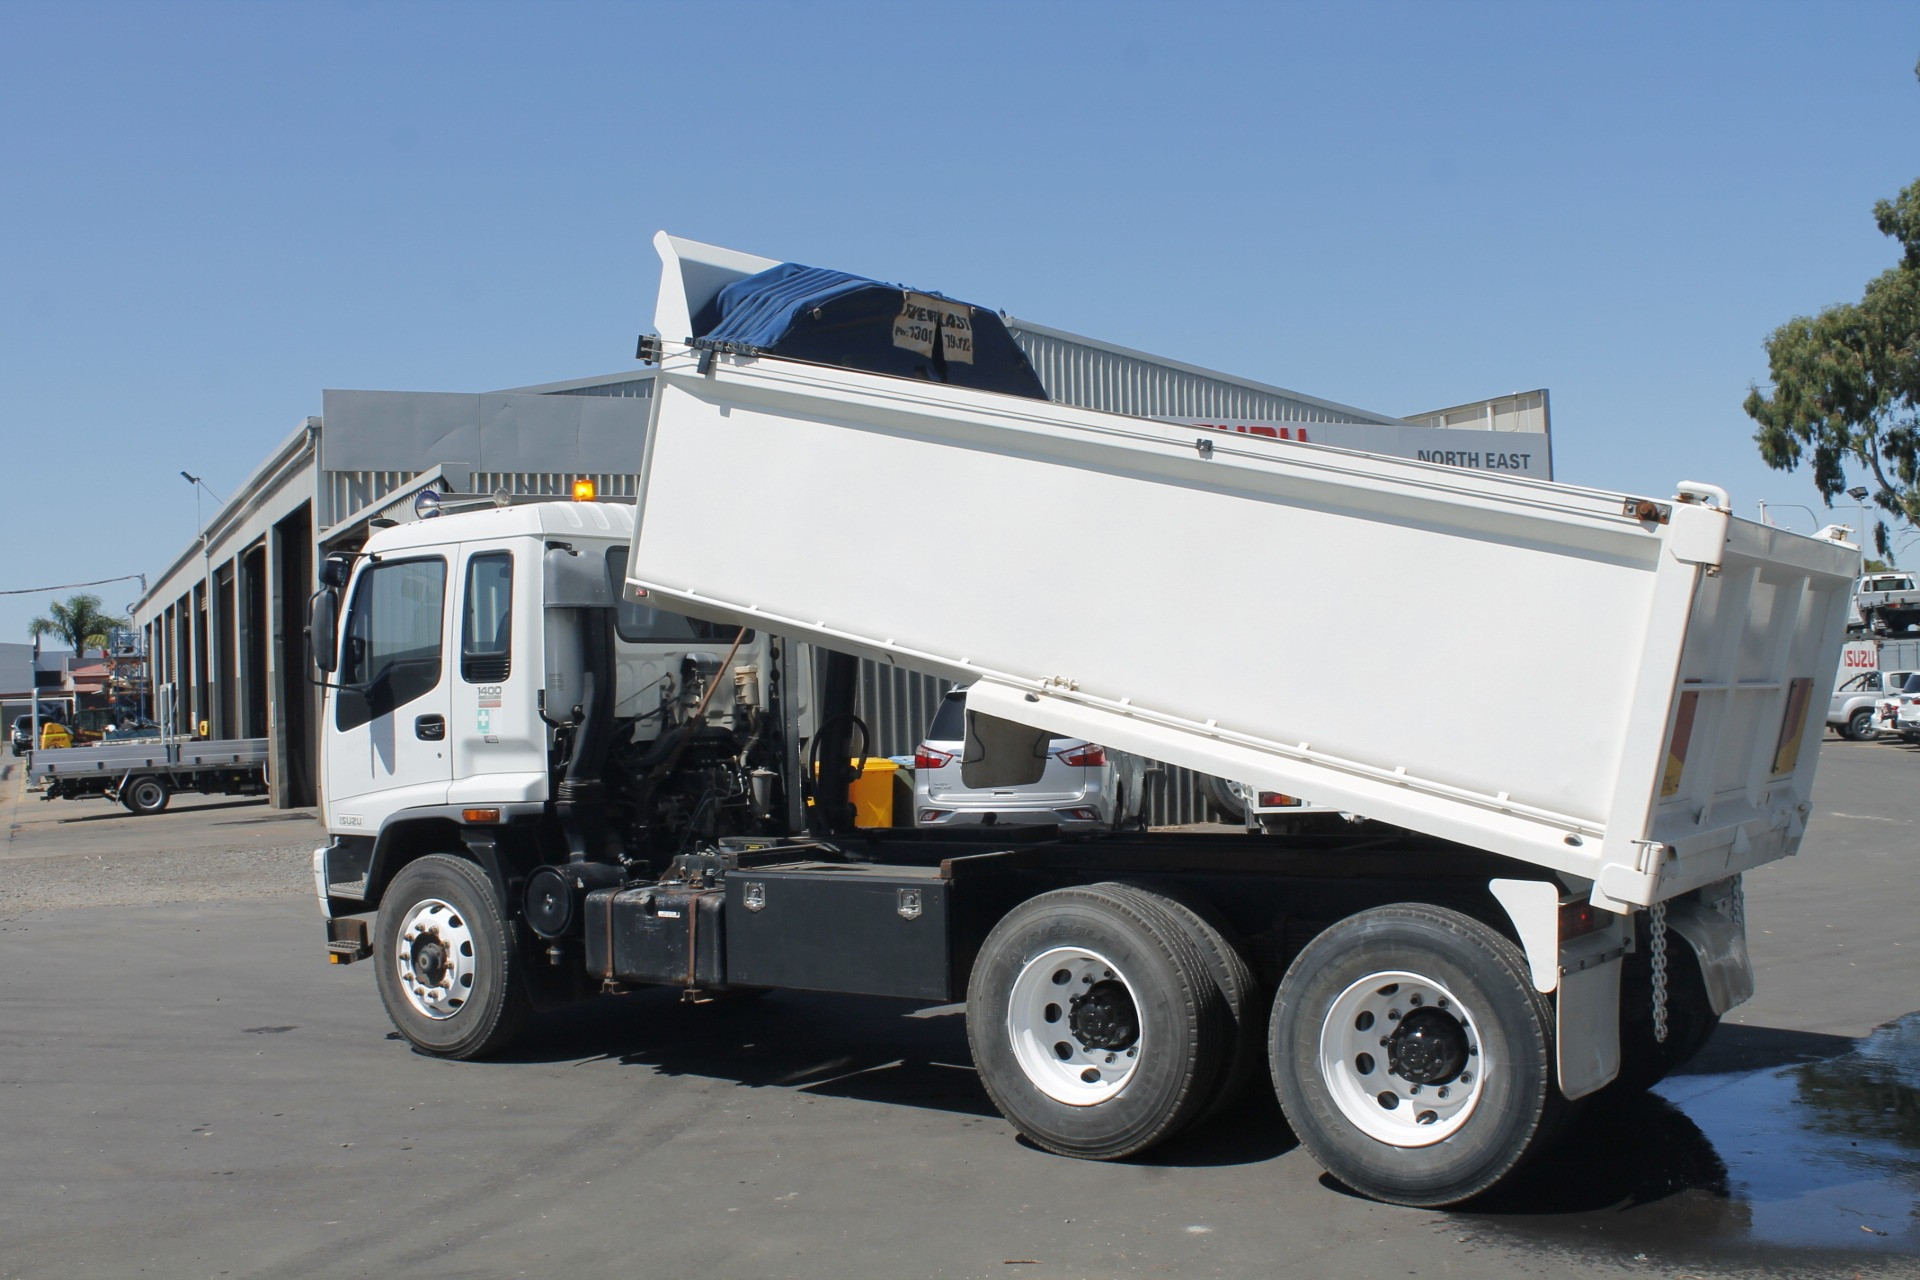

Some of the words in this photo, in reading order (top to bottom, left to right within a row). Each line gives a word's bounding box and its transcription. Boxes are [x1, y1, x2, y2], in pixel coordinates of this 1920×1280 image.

[1417, 449, 1480, 468] NORTH
[1486, 452, 1531, 470] EAST
[1844, 650, 1875, 668] ISUZU
[477, 686, 502, 696] 1400
[339, 816, 363, 826] ISUZU
